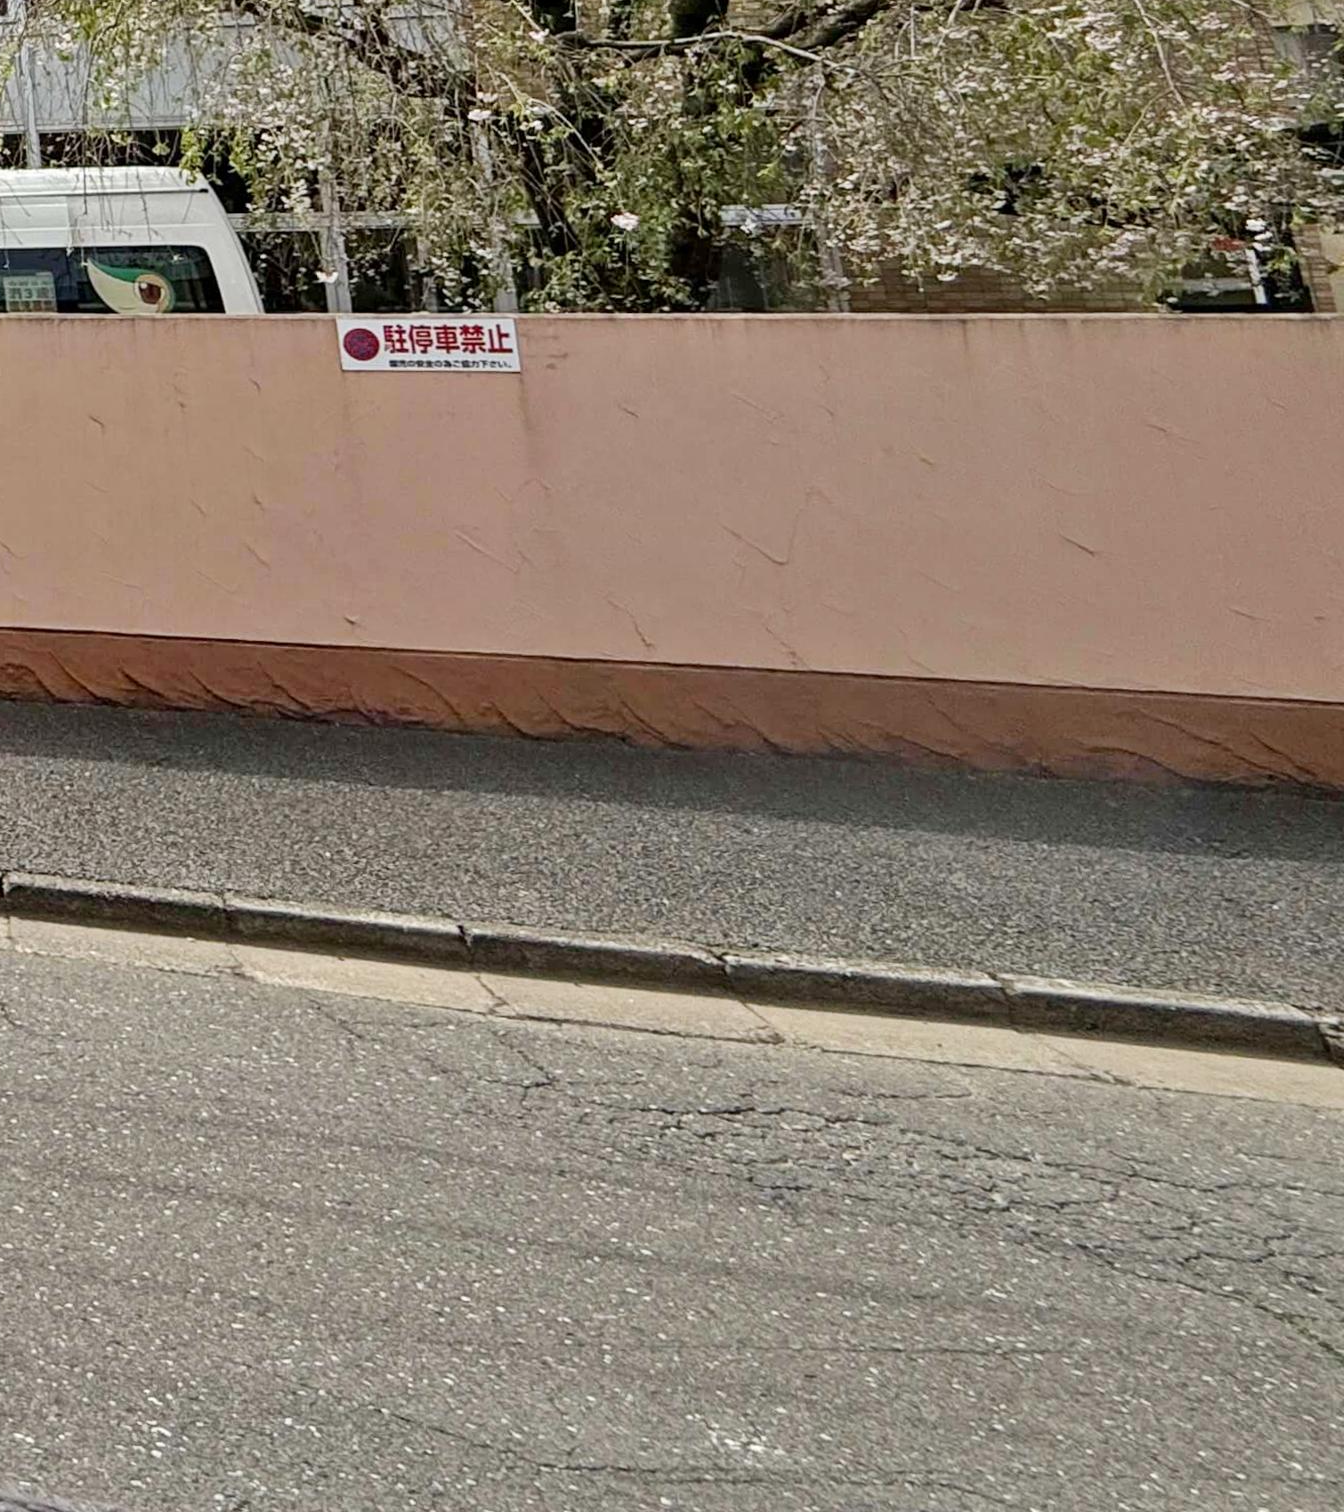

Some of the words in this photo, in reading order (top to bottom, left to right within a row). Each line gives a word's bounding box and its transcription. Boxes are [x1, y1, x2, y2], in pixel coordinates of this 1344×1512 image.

[383, 324, 513, 354] 駐停車禁止
